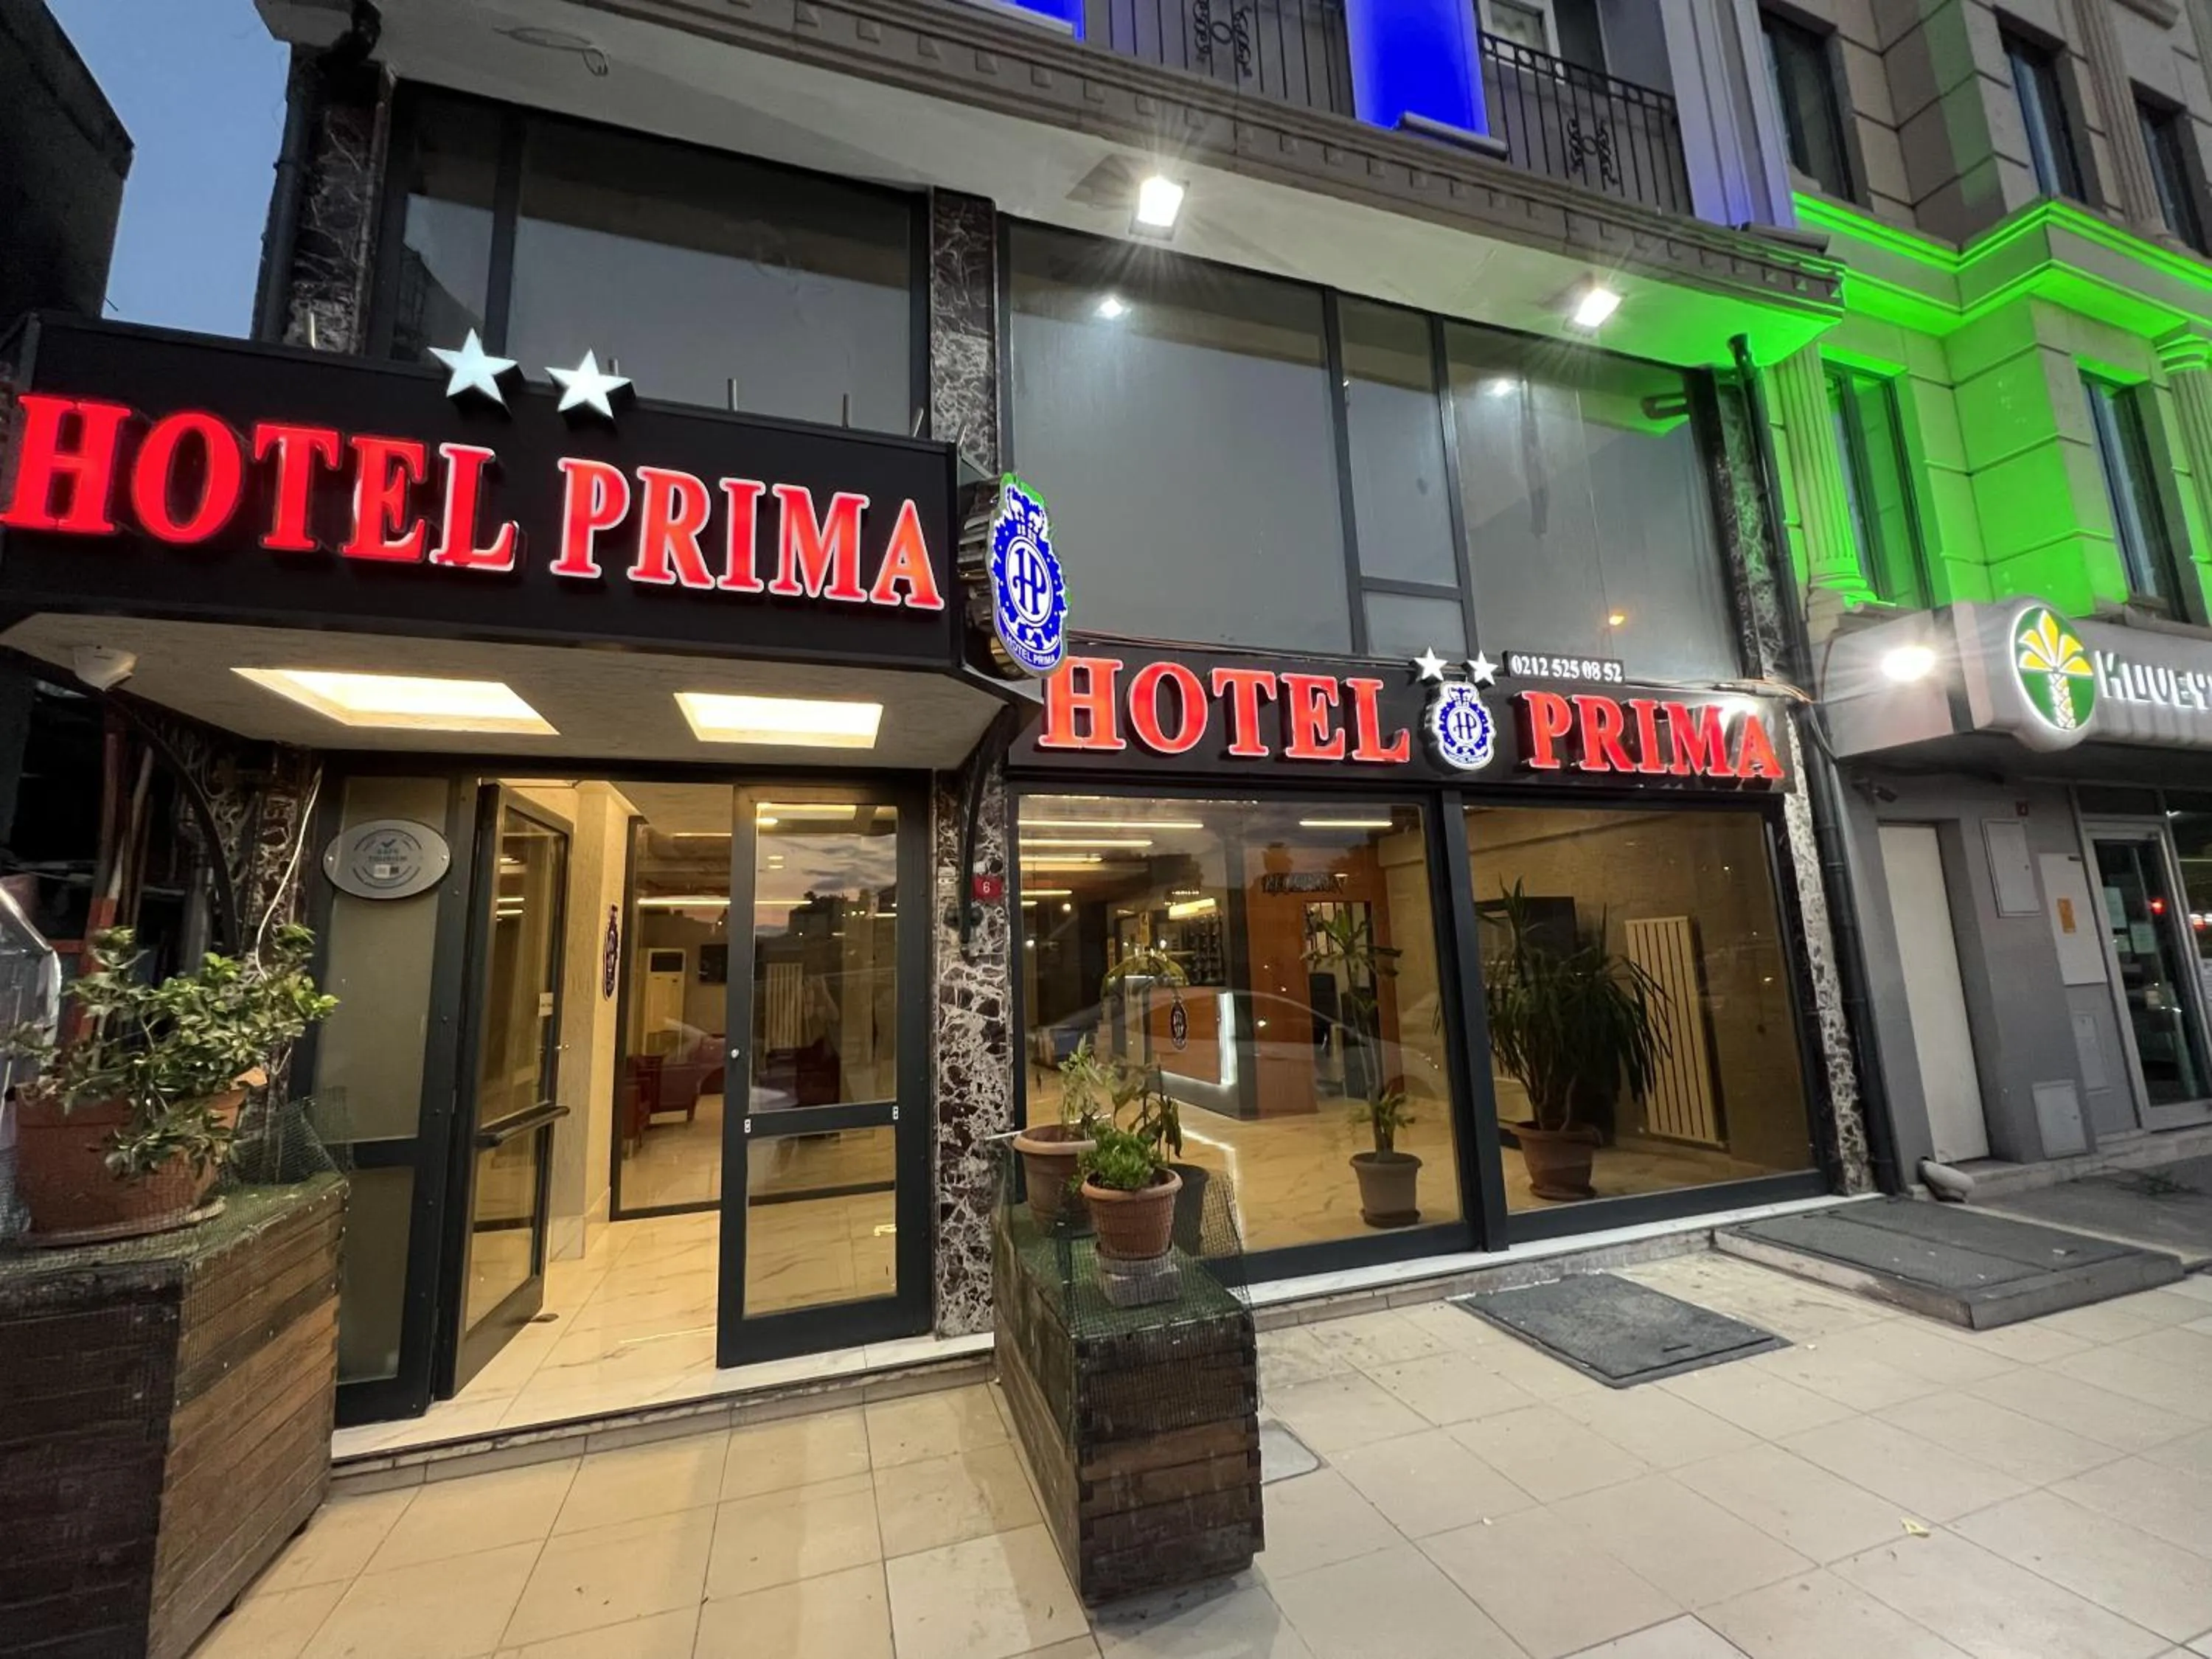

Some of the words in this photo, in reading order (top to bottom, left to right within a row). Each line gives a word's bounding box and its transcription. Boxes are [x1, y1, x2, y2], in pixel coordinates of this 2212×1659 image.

[0, 394, 519, 571] HOTEL
[549, 456, 945, 610] PRIMA
[1006, 633, 1032, 663] HOTEL
[1511, 655, 1548, 676] 0212
[1551, 658, 1580, 678] 525
[1582, 661, 1601, 681] 08
[1603, 662, 1622, 683] 52
[2094, 650, 2212, 710] KUVEY
[1038, 656, 1411, 762] HOTEL
[1520, 690, 1784, 779] PRIMA
